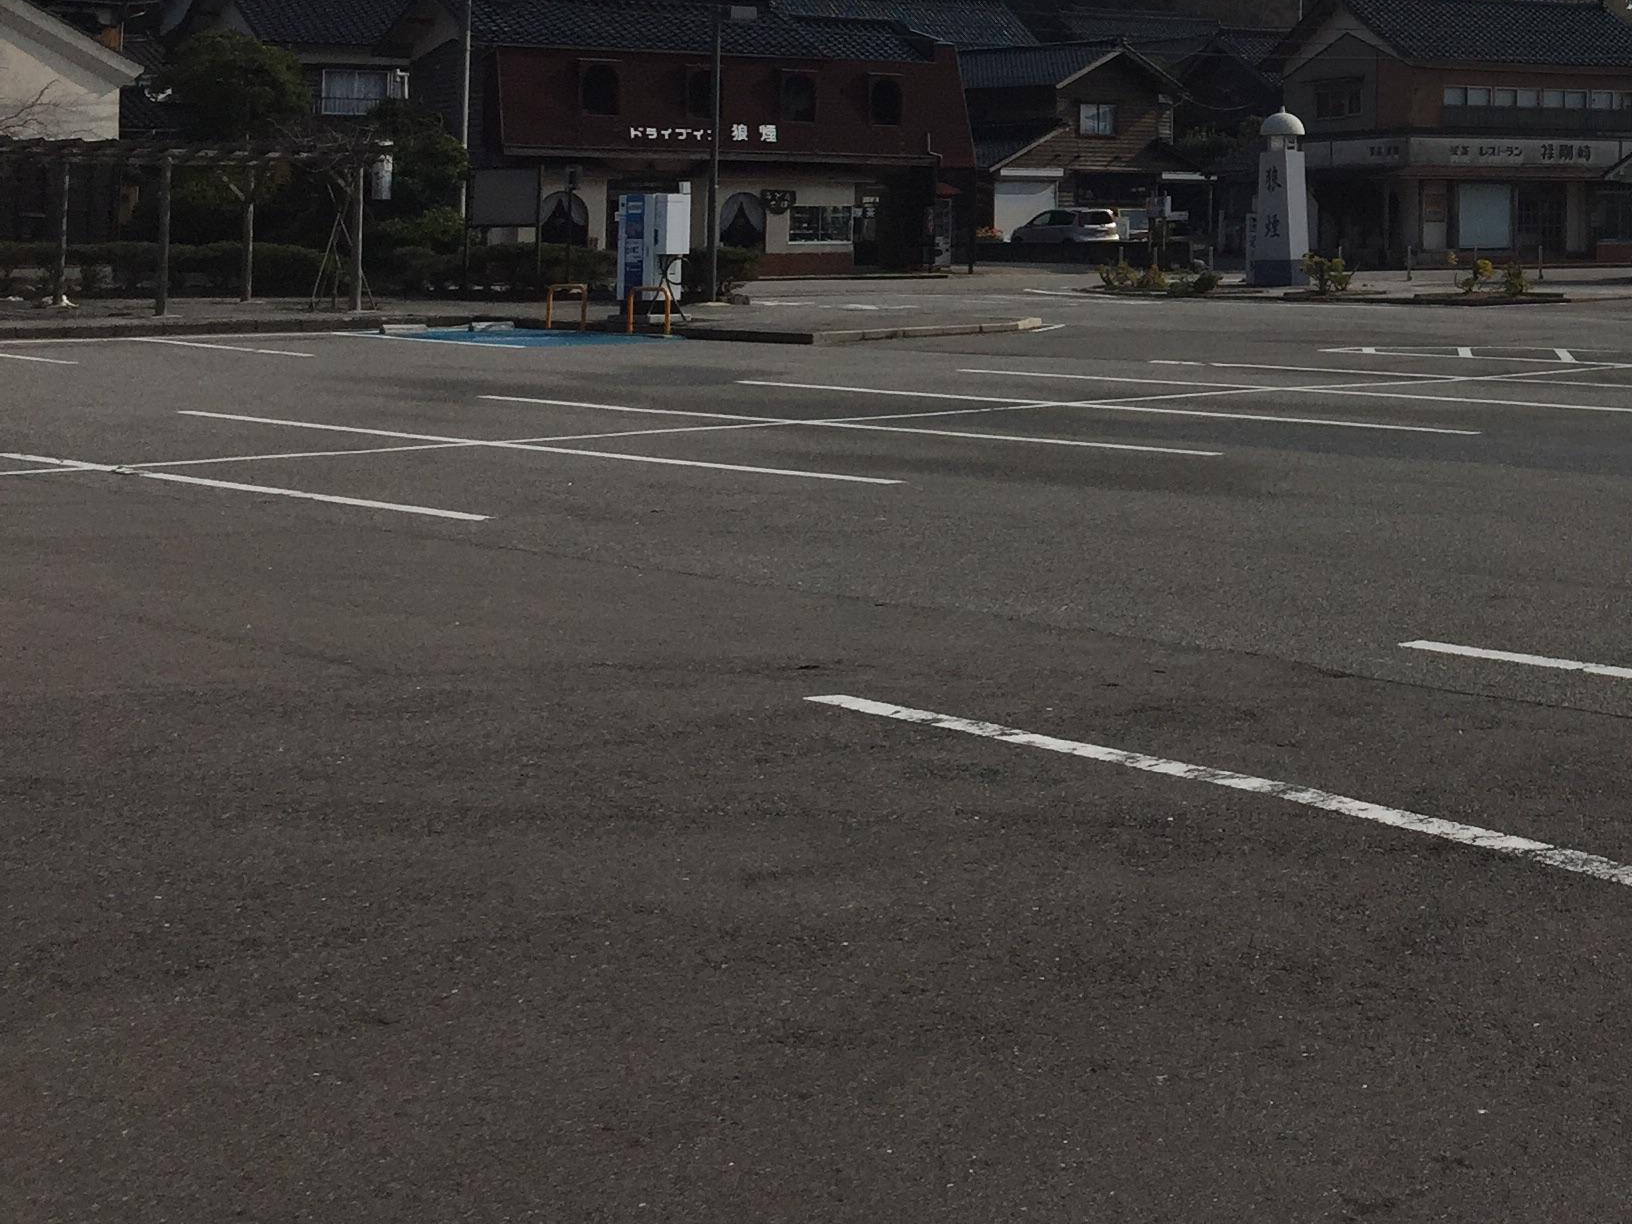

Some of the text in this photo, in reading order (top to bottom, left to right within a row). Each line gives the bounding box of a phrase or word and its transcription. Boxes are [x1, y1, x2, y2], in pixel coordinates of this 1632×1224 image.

[1479, 146, 1522, 157] レストラン
